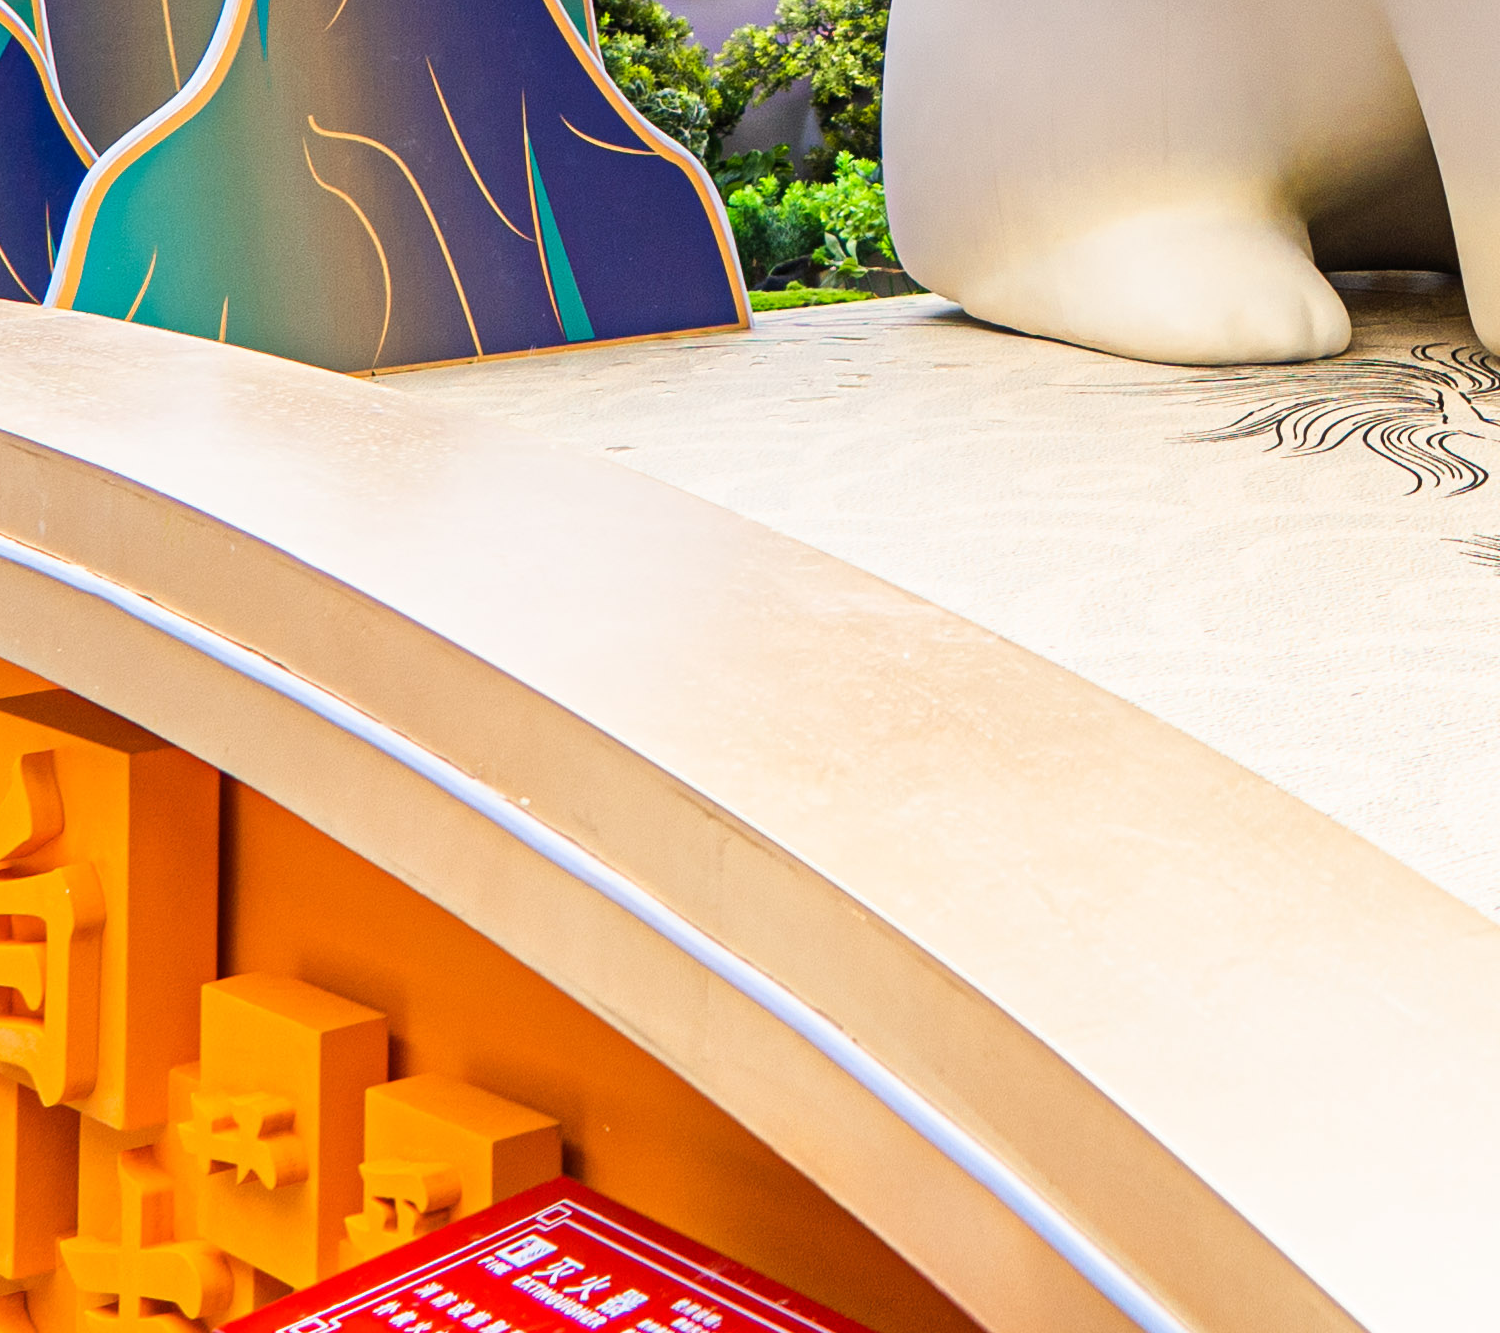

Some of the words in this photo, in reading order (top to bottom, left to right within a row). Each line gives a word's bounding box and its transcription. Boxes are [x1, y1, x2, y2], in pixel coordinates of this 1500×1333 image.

[477, 1255, 514, 1276] FIRE
[511, 1274, 608, 1330] EXTINGUISHER
[531, 1255, 650, 1320] 灭火器
